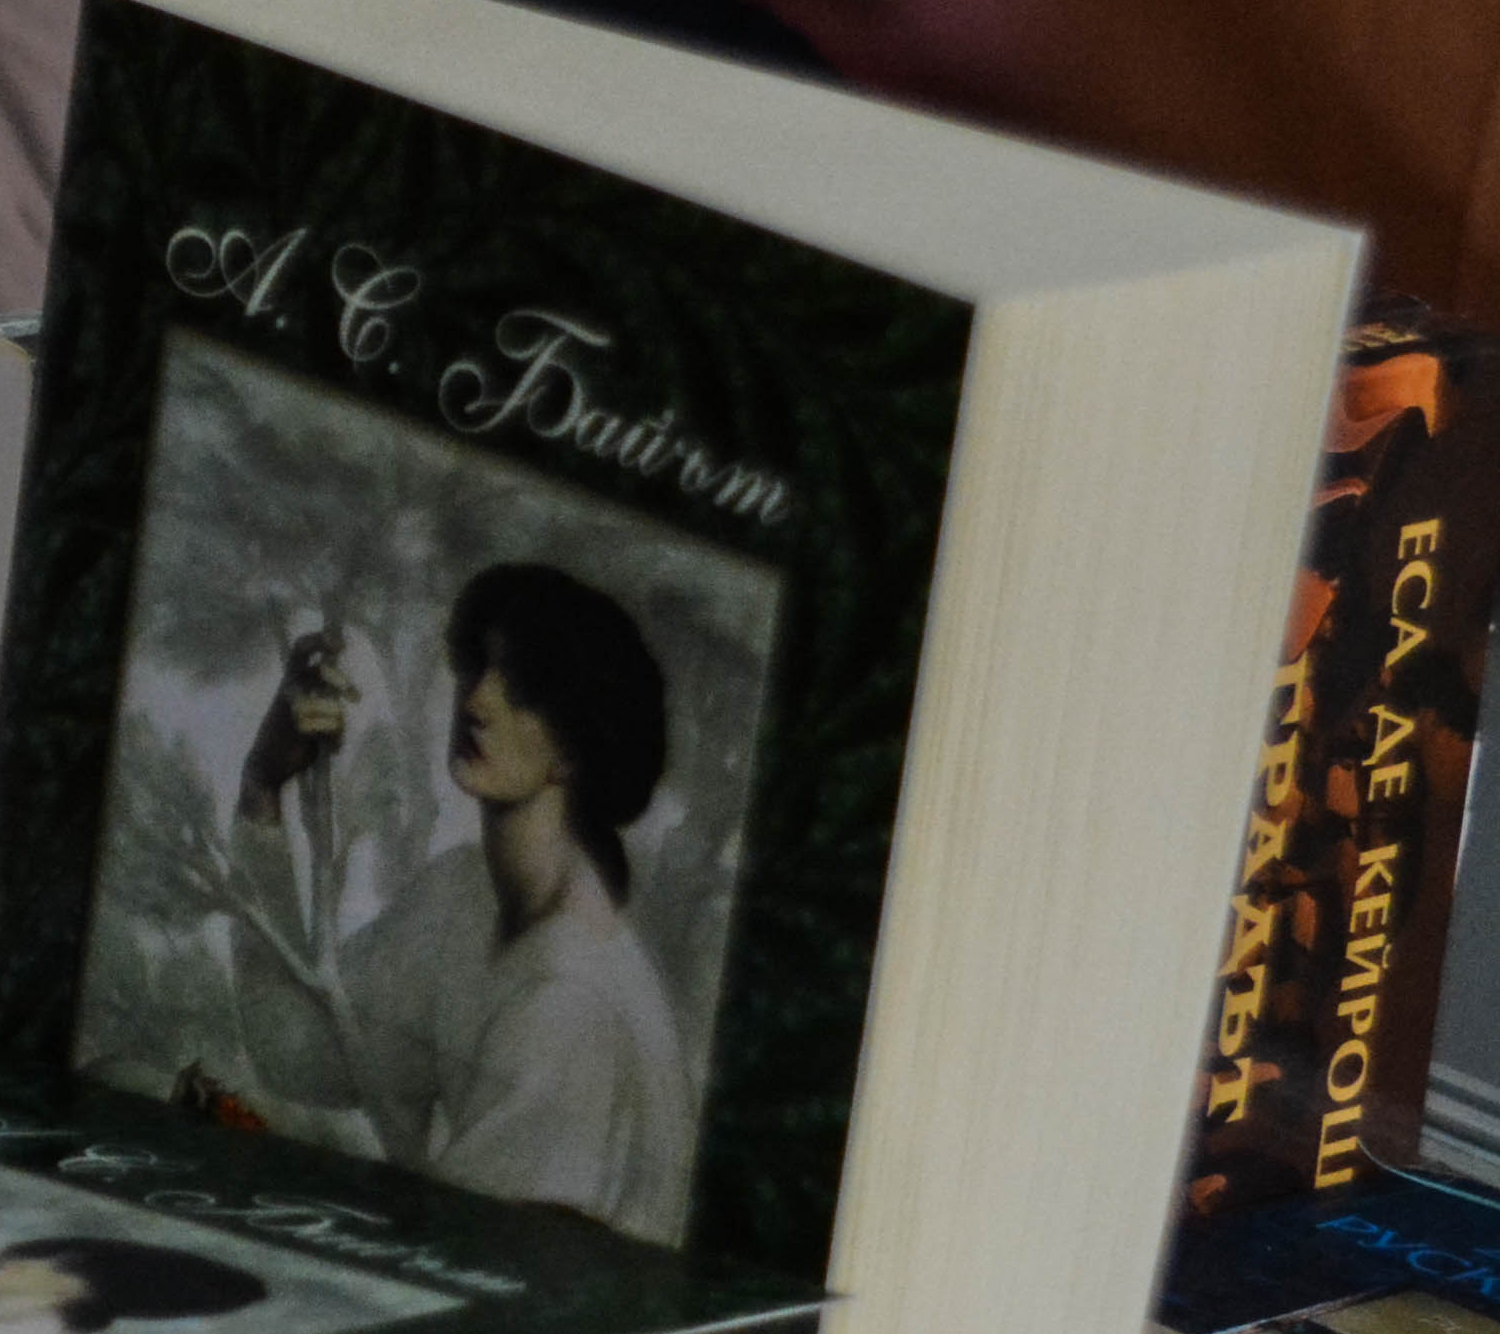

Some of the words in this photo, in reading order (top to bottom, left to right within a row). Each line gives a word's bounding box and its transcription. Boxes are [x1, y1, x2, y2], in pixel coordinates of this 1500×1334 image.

[1382, 516, 1443, 670] ЕСА
[1360, 704, 1417, 803] ДЕ
[1312, 841, 1401, 1191] КЕЙРОШ
